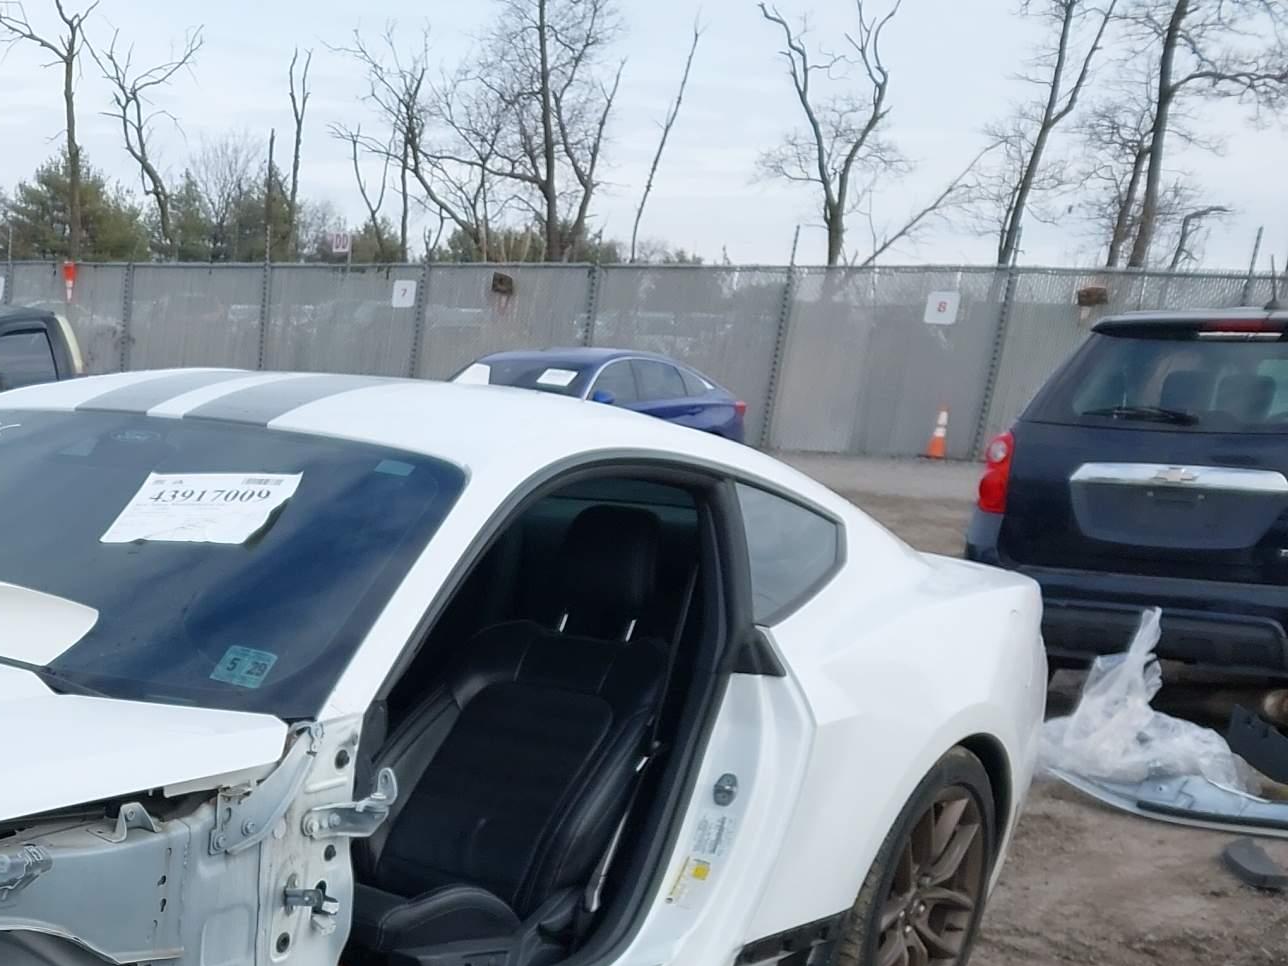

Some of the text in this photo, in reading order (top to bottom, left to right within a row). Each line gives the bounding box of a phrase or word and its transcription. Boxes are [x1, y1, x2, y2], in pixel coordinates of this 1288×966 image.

[400, 288, 408, 297] 7
[148, 488, 272, 503] 43917009
[226, 656, 241, 672] 5
